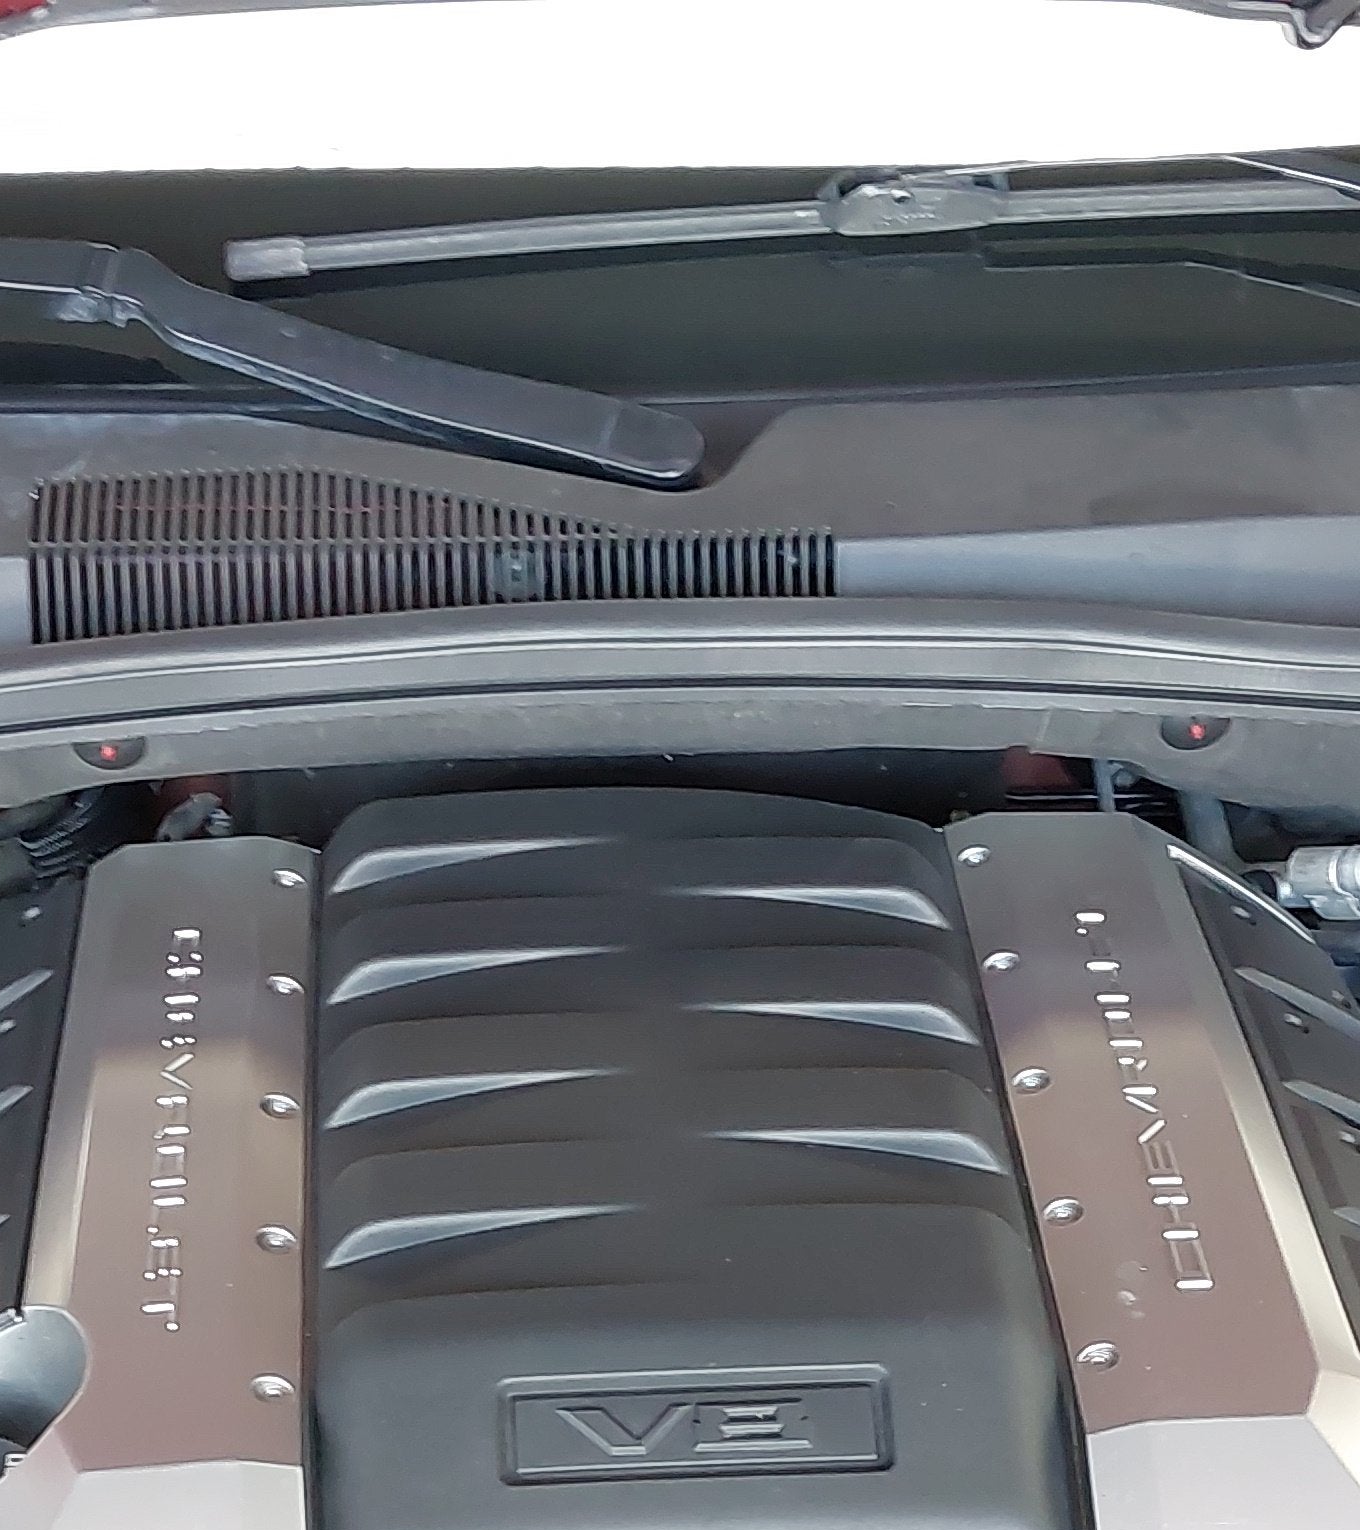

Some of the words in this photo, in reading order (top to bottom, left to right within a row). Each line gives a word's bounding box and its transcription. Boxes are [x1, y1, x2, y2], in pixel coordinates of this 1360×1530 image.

[141, 928, 203, 1333] CHEVROLET
[1074, 909, 1215, 1291] CHEVROLET
[554, 1396, 814, 1458] V8
